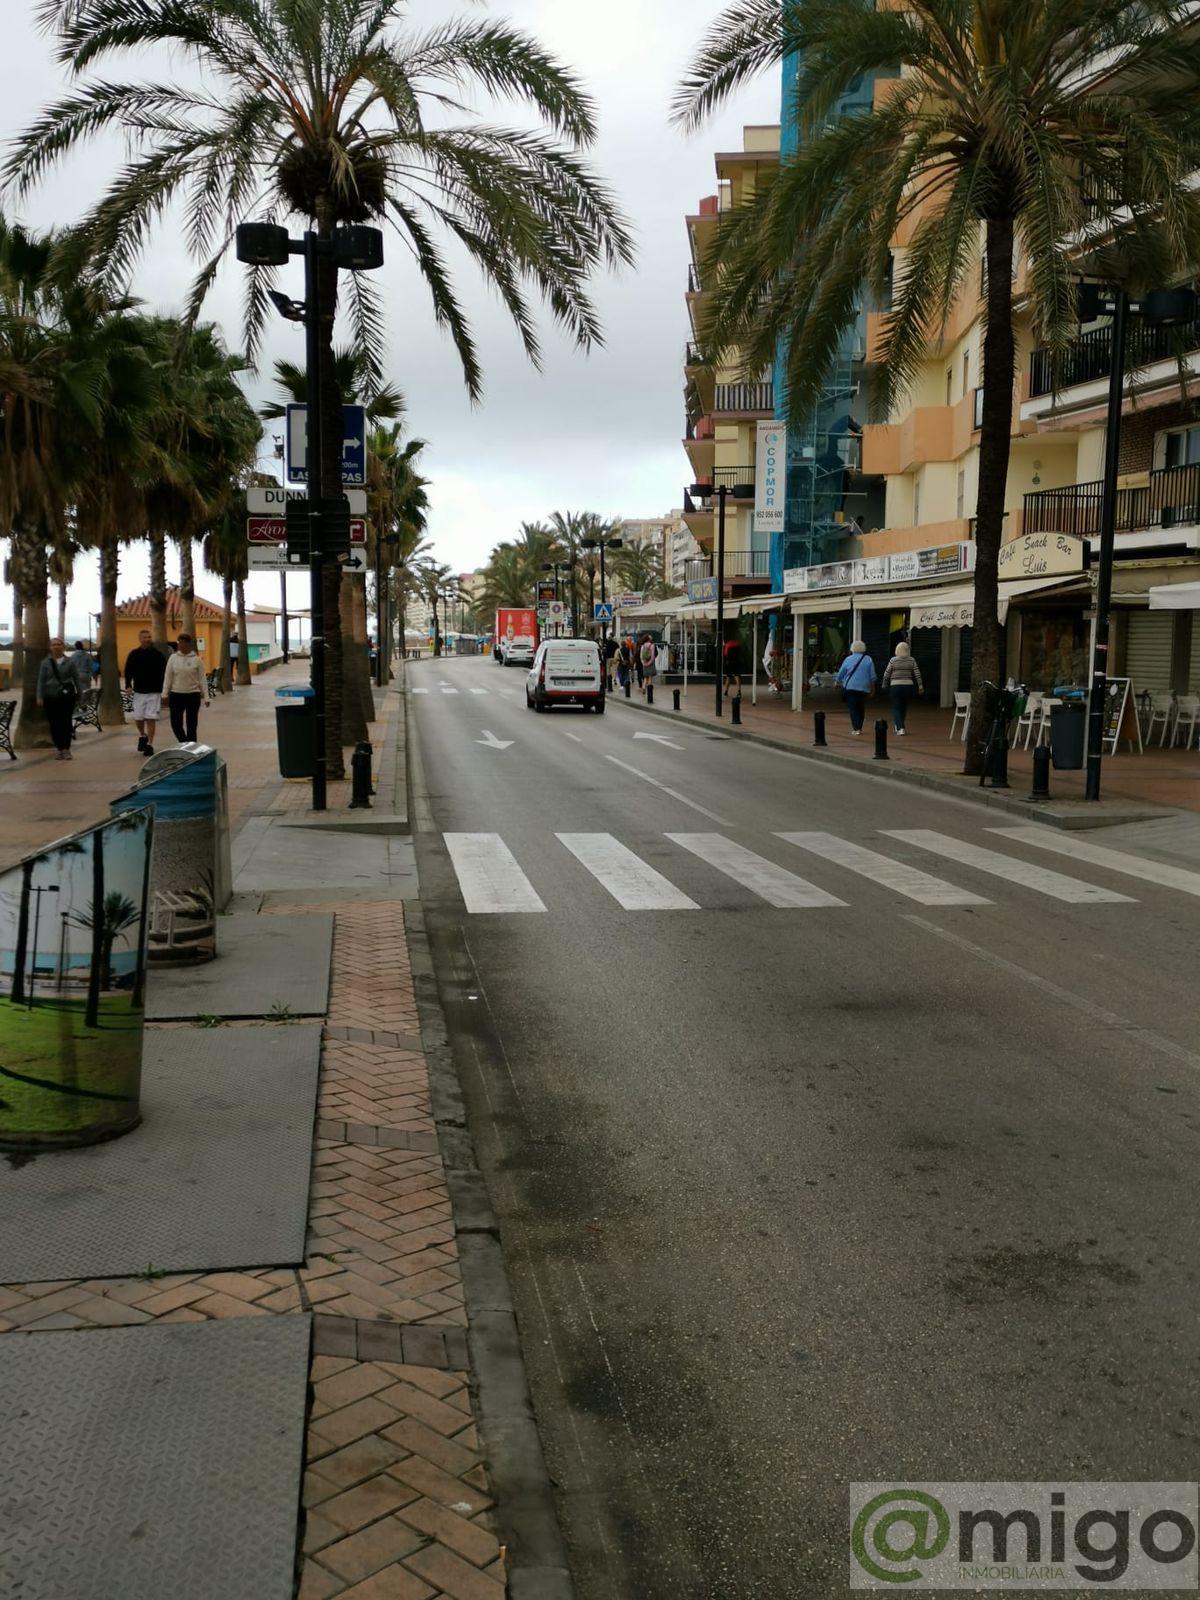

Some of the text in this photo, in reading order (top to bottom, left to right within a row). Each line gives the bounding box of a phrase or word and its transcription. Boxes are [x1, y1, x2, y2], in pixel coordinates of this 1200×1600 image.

[342, 461, 359, 469] 00m
[766, 447, 776, 506] COPMOR
[1024, 534, 1048, 551] Snack
[1056, 536, 1072, 555] Bar
[1022, 553, 1048, 574] Luis
[936, 611, 957, 621] Snack
[960, 609, 973, 620] Bar
